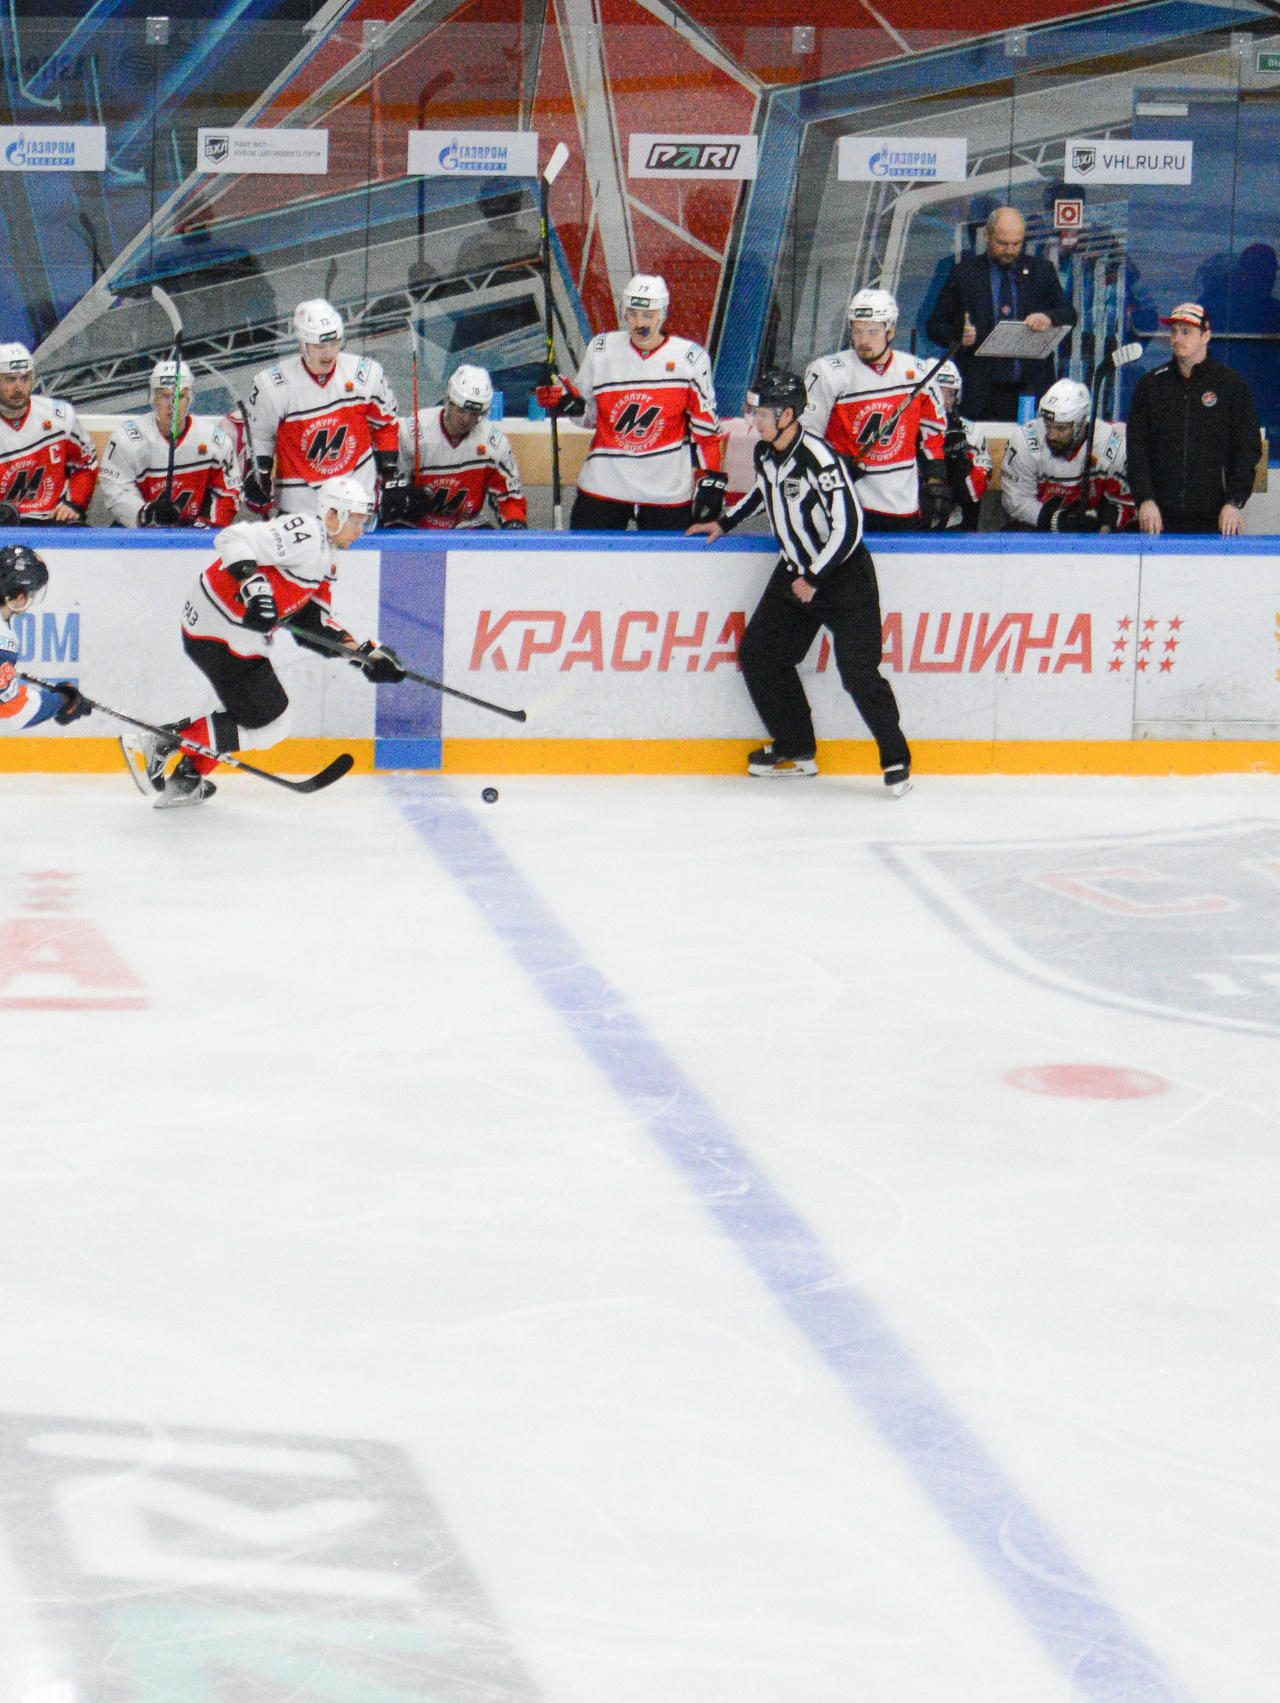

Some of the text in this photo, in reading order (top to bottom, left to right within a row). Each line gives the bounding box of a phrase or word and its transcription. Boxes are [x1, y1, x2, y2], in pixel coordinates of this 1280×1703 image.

[27, 141, 75, 154] ГАЗПРОМ
[460, 146, 507, 159] ГАЗПРОМ
[648, 145, 737, 168] PARI
[889, 152, 937, 165] ГАЗПРОМ
[1103, 154, 1186, 170] VHLRU.RU
[818, 468, 845, 492] 81
[283, 515, 312, 544] 94
[469, 610, 747, 673] КРАСНА
[815, 611, 1093, 675] АШИНА
